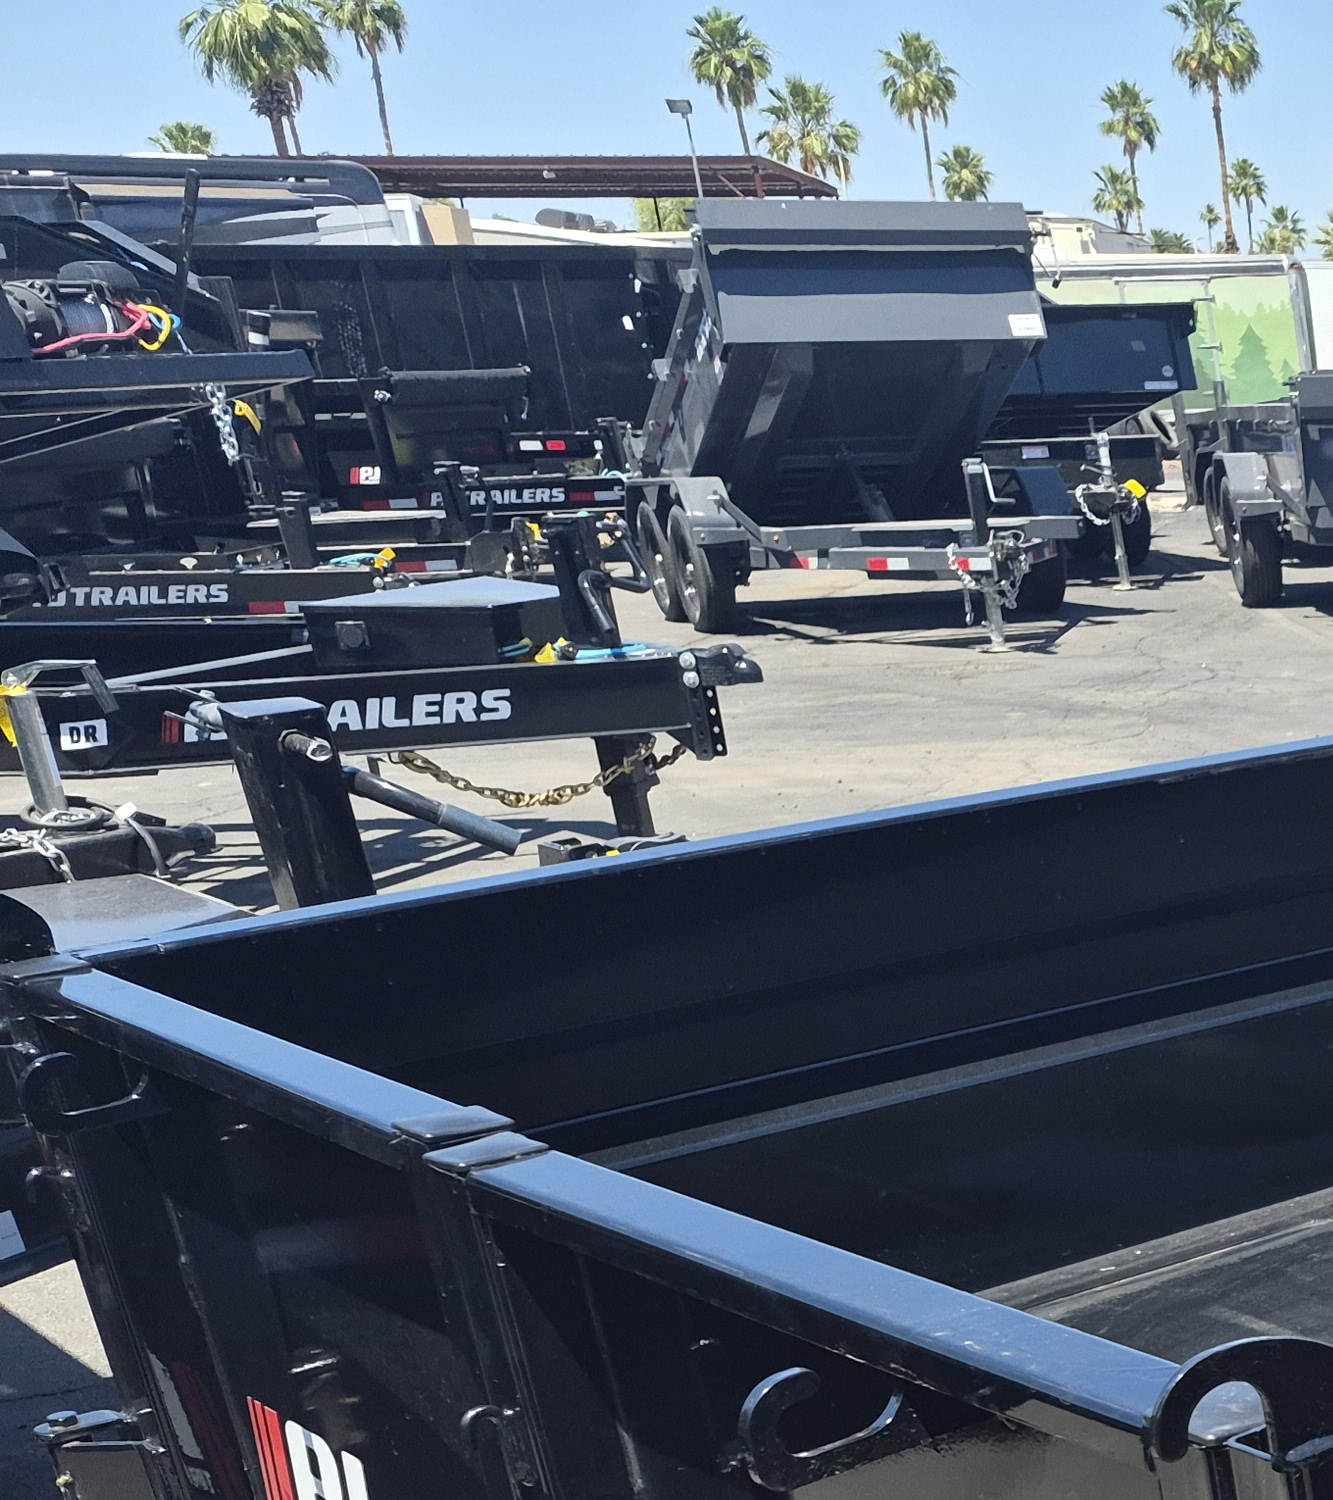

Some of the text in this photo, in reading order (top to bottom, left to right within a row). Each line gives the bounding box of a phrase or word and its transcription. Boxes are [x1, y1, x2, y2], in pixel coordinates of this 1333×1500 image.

[466, 487, 566, 506] RAILERS
[70, 583, 230, 607] TRAILERS
[327, 687, 513, 733] AILERS
[69, 723, 98, 744] DR
